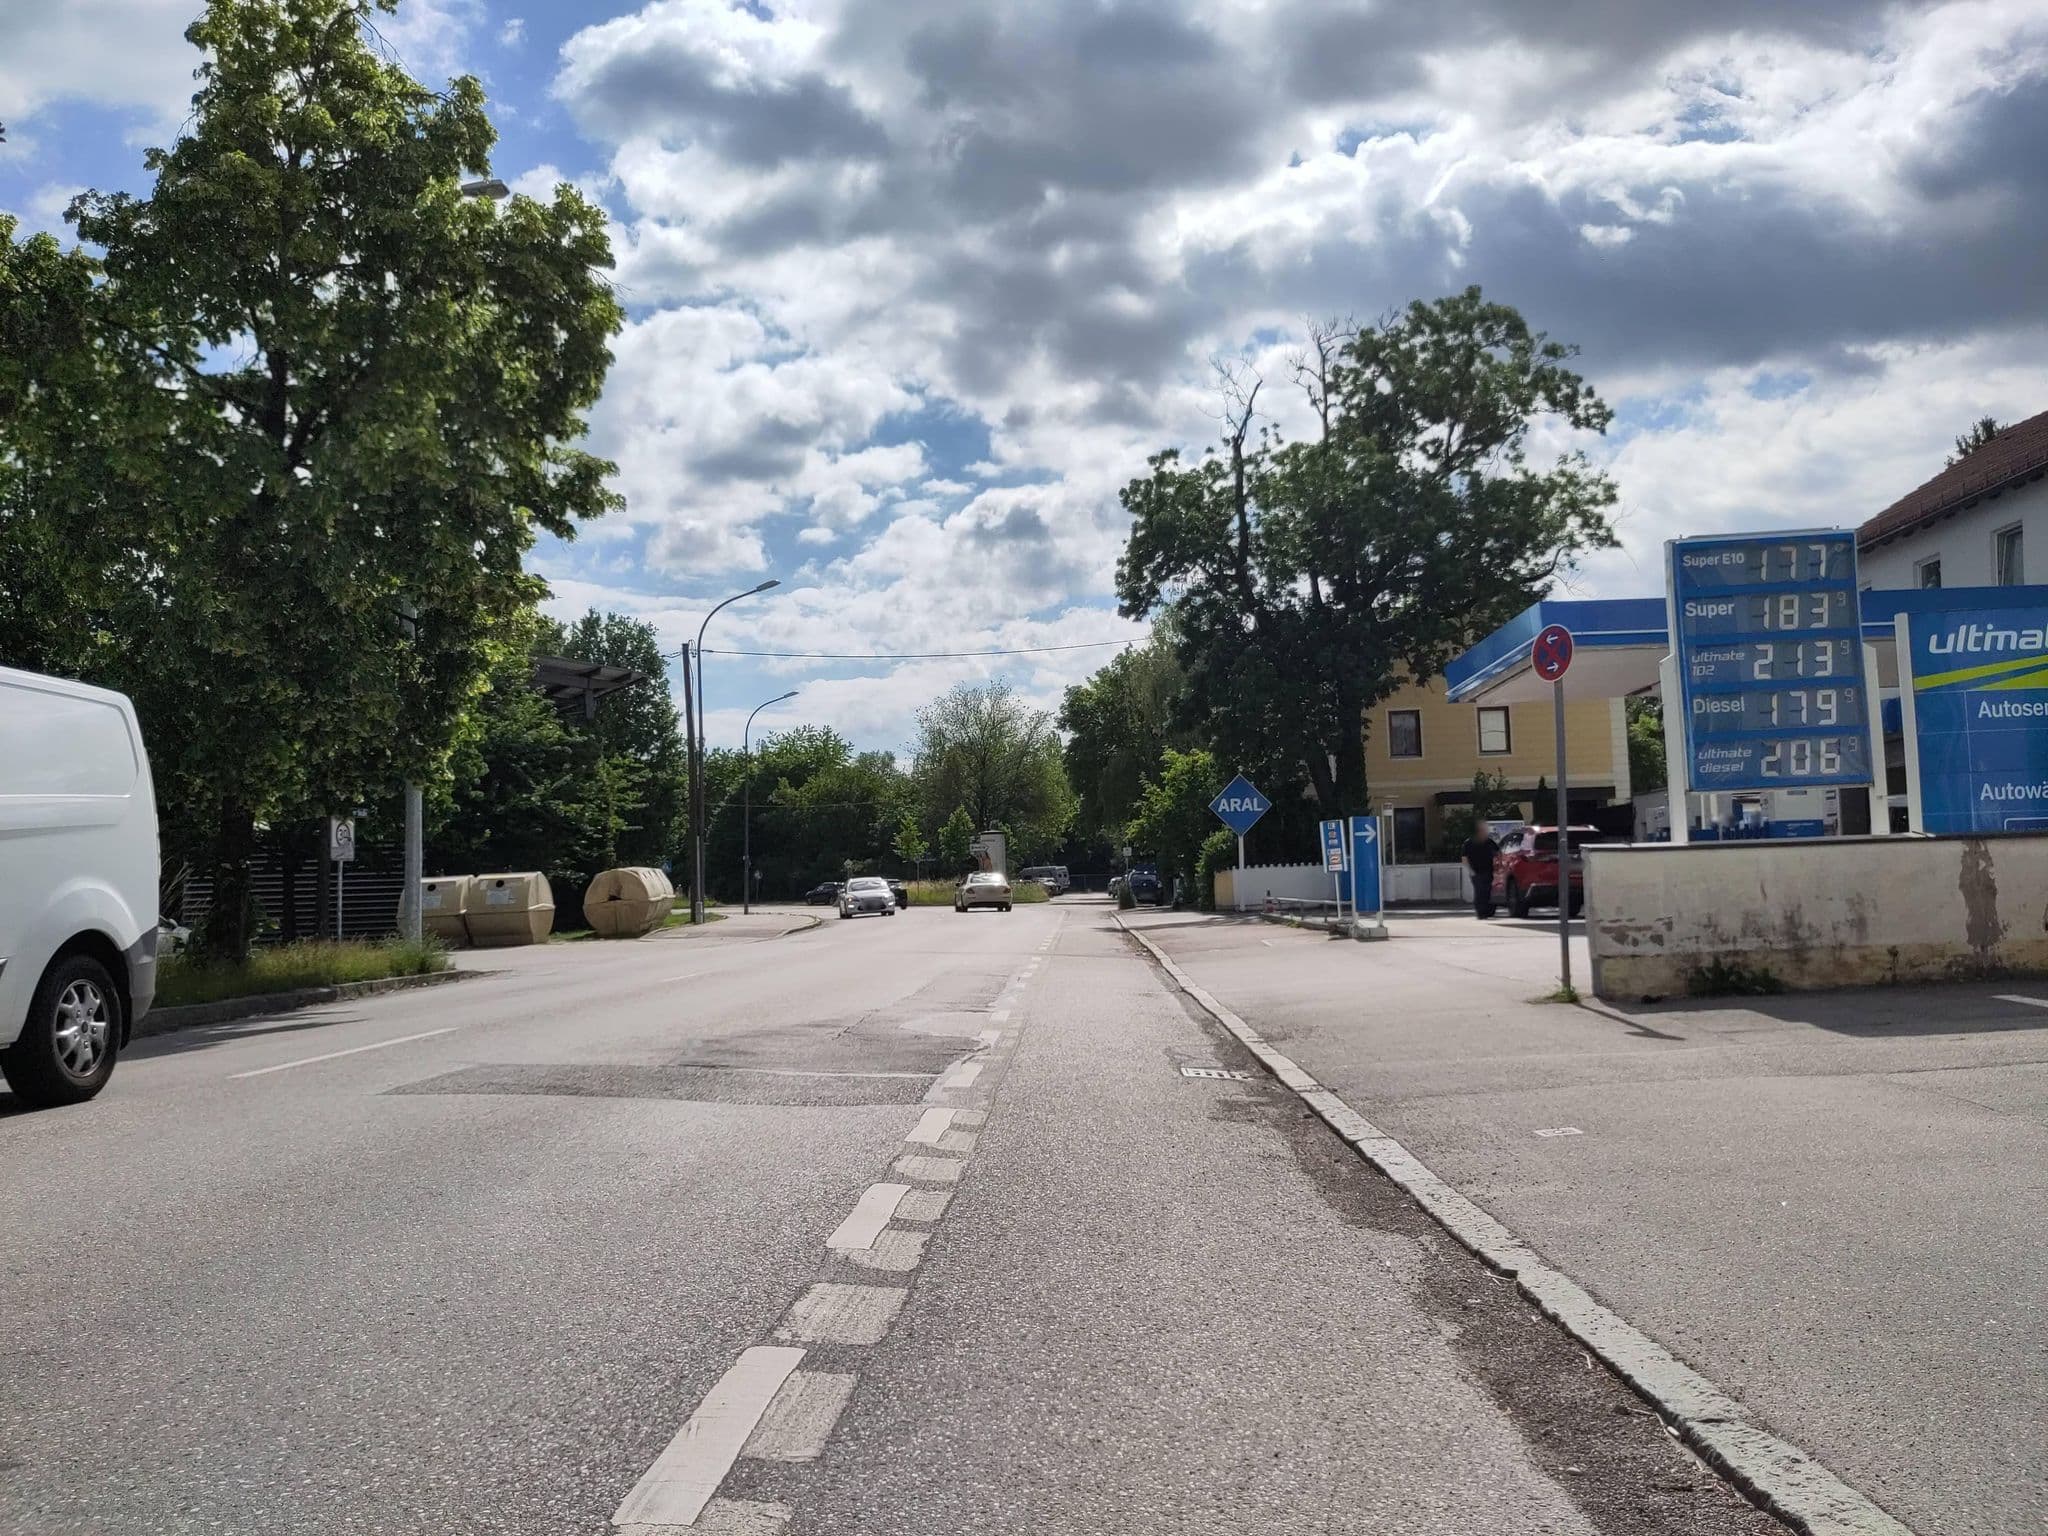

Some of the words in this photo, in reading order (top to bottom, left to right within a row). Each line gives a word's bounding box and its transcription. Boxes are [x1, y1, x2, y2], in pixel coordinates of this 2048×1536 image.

[1682, 555, 1719, 568] Super
[1722, 552, 1745, 565] E10
[1760, 544, 1826, 581] 177
[1685, 603, 1735, 619] Super
[1763, 593, 1829, 630] 183
[1929, 623, 2048, 654] ultimat
[1691, 650, 1745, 663] ultimate
[1753, 641, 1833, 680] 213
[1692, 665, 1715, 676] 102
[1693, 696, 1745, 714] Diesel
[1771, 689, 1837, 726] 179
[1698, 747, 1752, 760] ultimate
[1760, 738, 1840, 777] 206
[1699, 762, 1744, 774] diesel
[1218, 797, 1264, 812] ARAL
